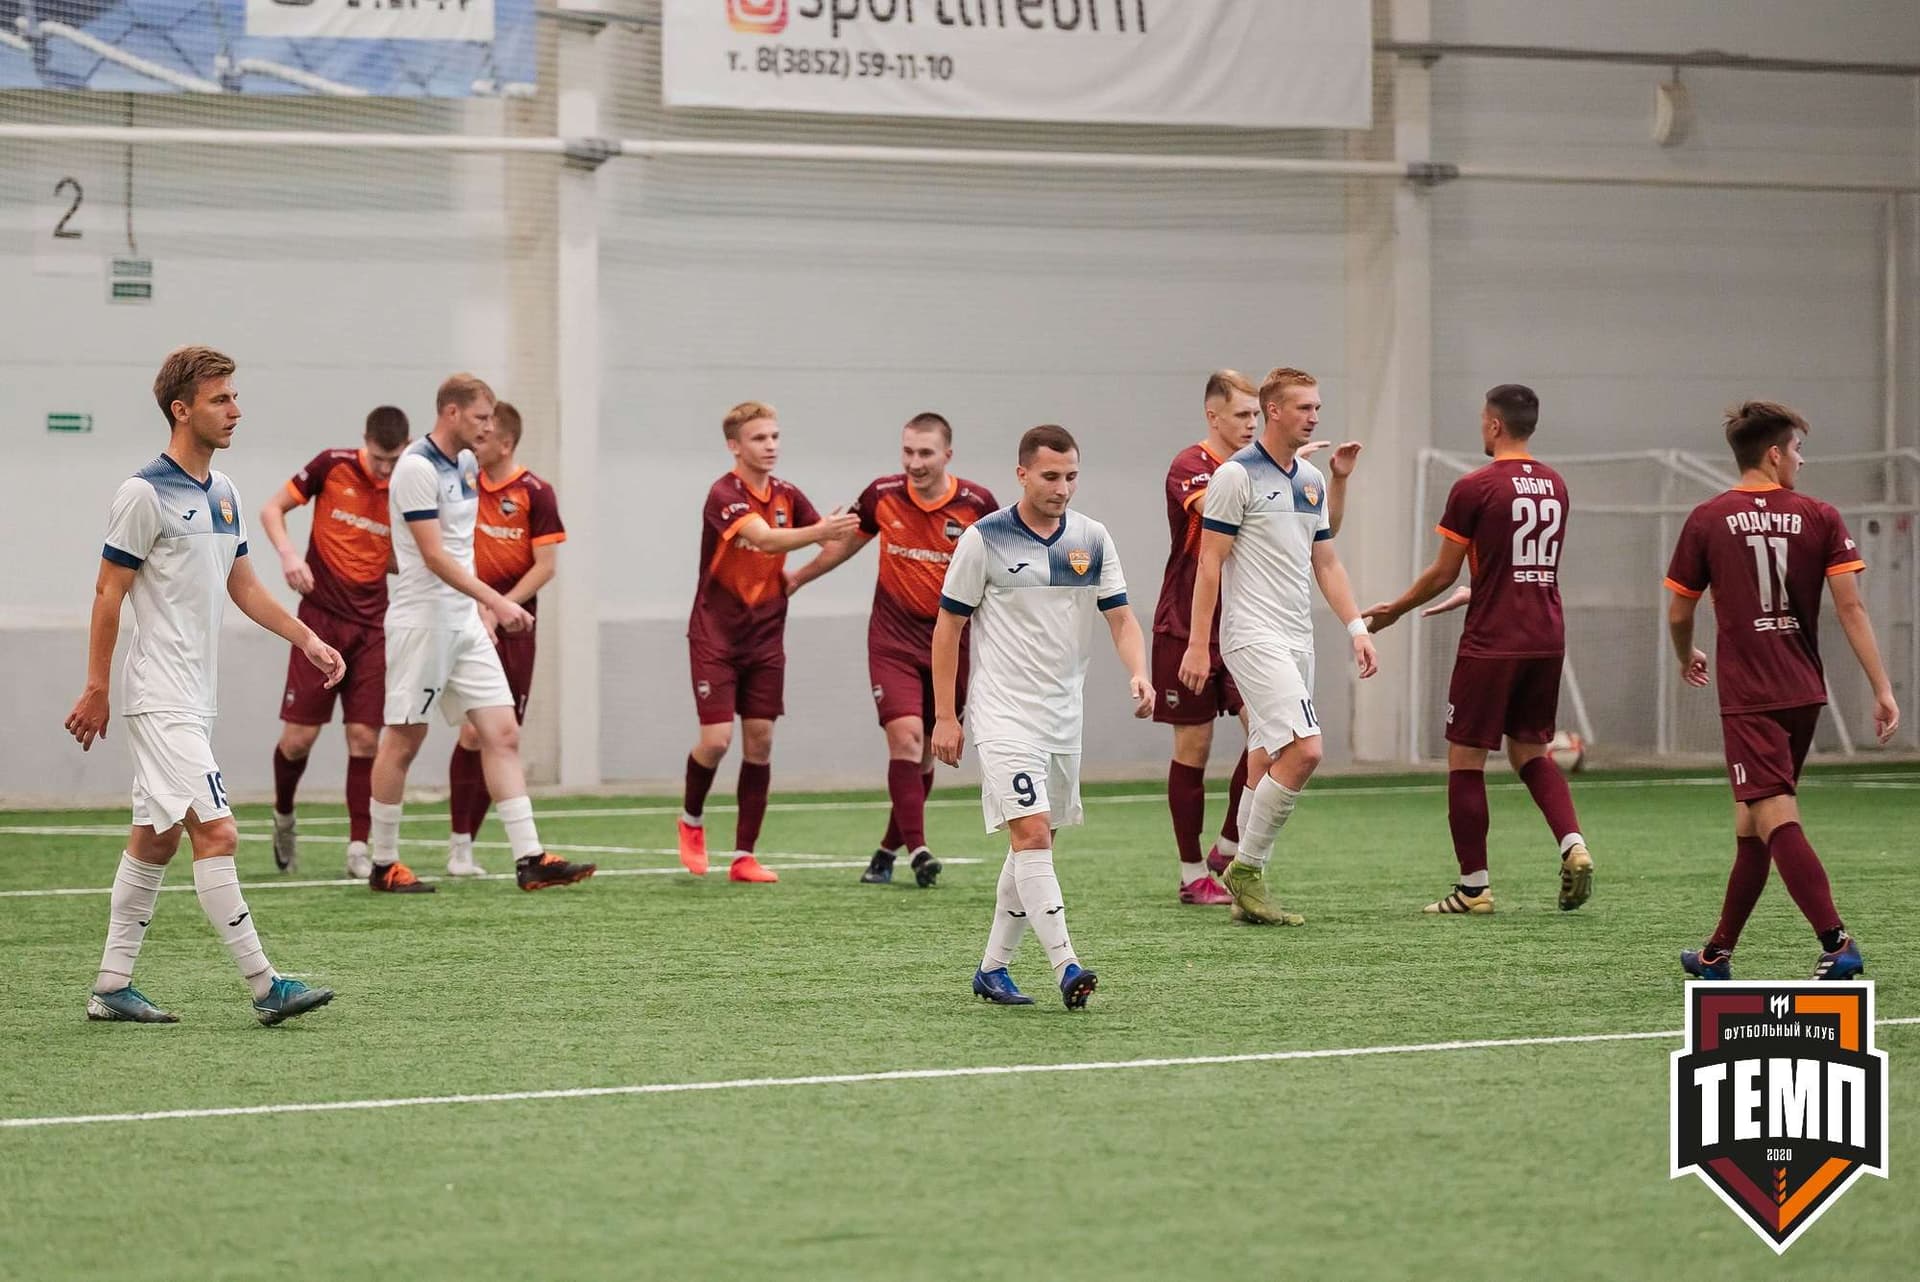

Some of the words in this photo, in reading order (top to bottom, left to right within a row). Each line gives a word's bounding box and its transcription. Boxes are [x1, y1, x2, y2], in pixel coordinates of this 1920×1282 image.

[757, 47, 850, 78] 8(3852)
[858, 51, 954, 80] 59-11-10
[53, 176, 83, 239] 2
[1511, 477, 1555, 496] БАБИЧ
[1511, 497, 1562, 566] 22
[1726, 511, 1802, 535] РОДИЧЕВ
[1745, 535, 1789, 613] 11
[1012, 772, 1037, 807] 9
[1733, 762, 1747, 785] 11
